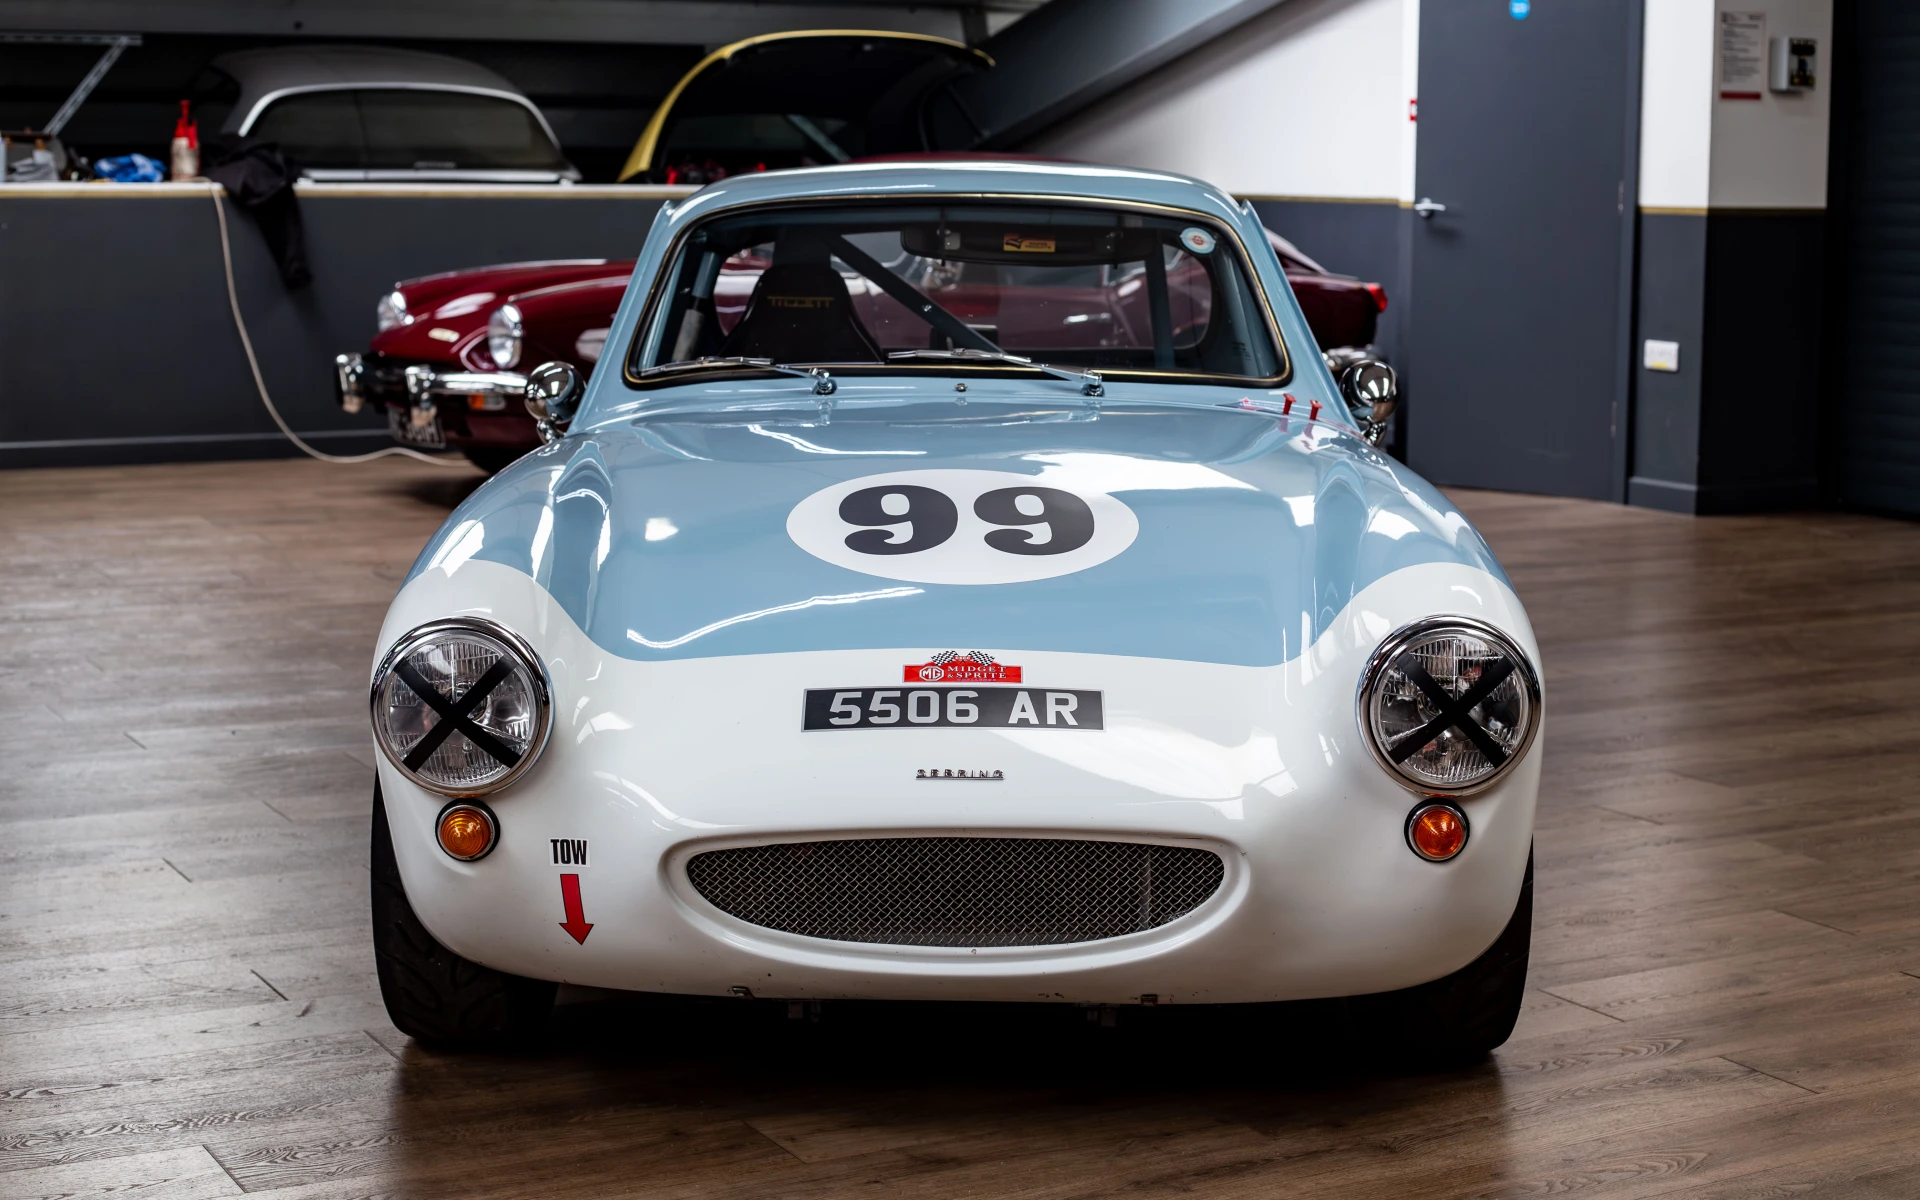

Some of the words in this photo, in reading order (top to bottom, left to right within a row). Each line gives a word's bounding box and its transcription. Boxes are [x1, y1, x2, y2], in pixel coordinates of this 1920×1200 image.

[838, 484, 1095, 556] 99
[921, 668, 942, 680] MG
[947, 665, 1007, 673] MIDGET
[828, 690, 979, 726] 5506
[1007, 690, 1079, 726] AR
[916, 768, 1004, 779] SEBRING
[550, 838, 588, 866] TOW
